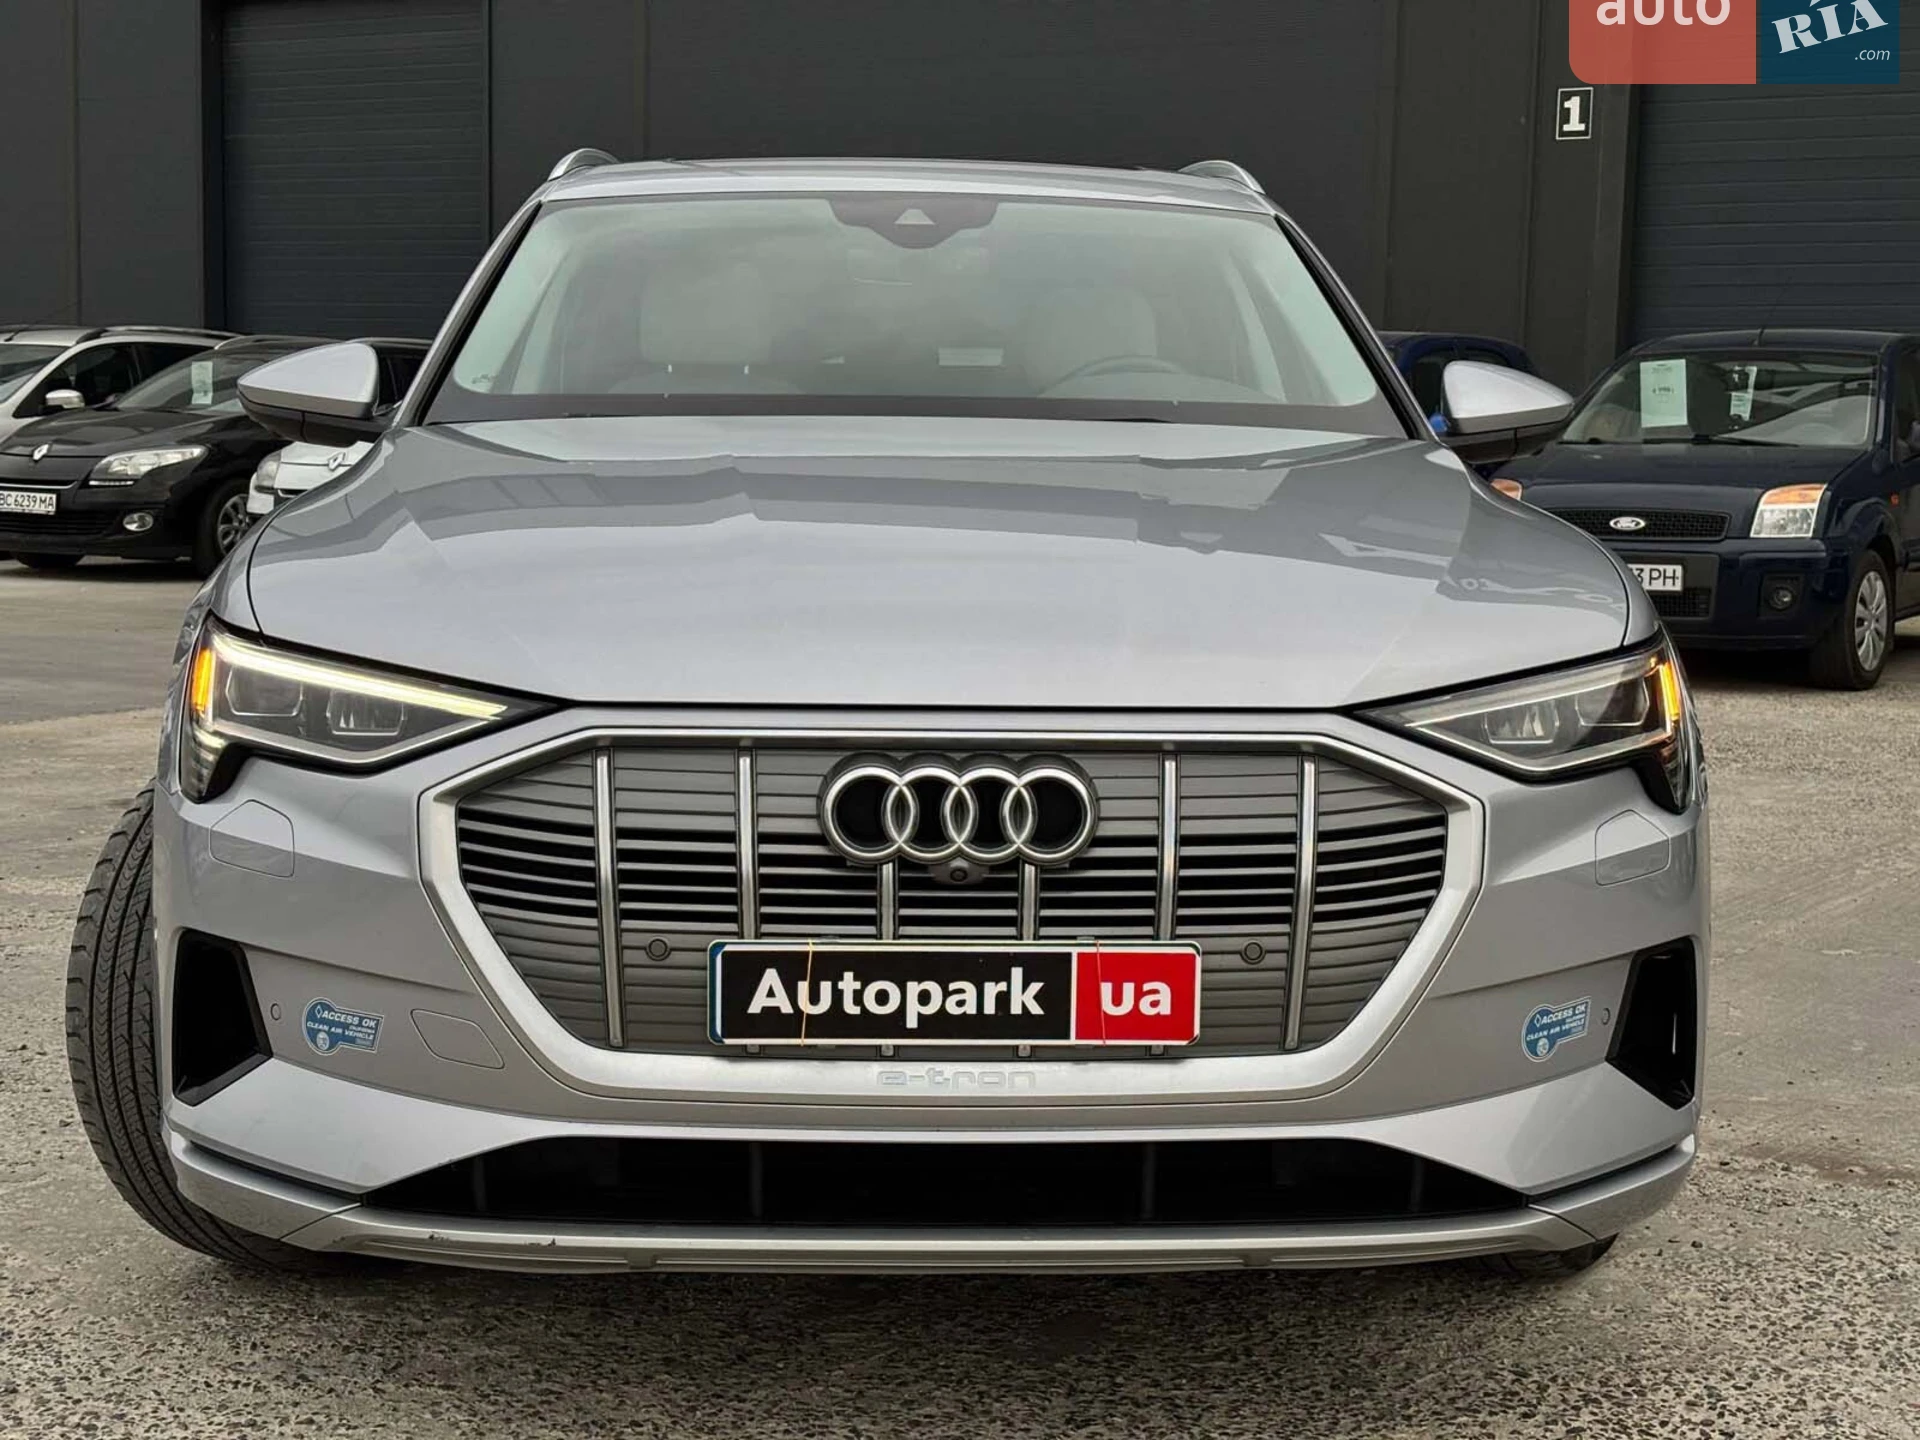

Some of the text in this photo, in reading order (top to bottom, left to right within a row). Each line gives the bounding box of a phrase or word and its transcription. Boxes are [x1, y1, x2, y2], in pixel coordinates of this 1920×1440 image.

[1562, 95, 1587, 132] 1
[14, 494, 38, 508] 6239
[40, 496, 55, 509] MA
[1649, 568, 1676, 586] PH
[746, 967, 1172, 1029] Autopark ua
[322, 1010, 377, 1028] ACCESS OK
[1541, 1007, 1573, 1025] ACCESS
[1575, 1003, 1586, 1014] OK
[306, 1021, 330, 1031] CLEAN
[330, 1026, 343, 1034] AIR
[345, 1029, 374, 1040] VEHICLE
[1526, 1030, 1548, 1041] CLEAN
[876, 1067, 1036, 1089] e-tron
